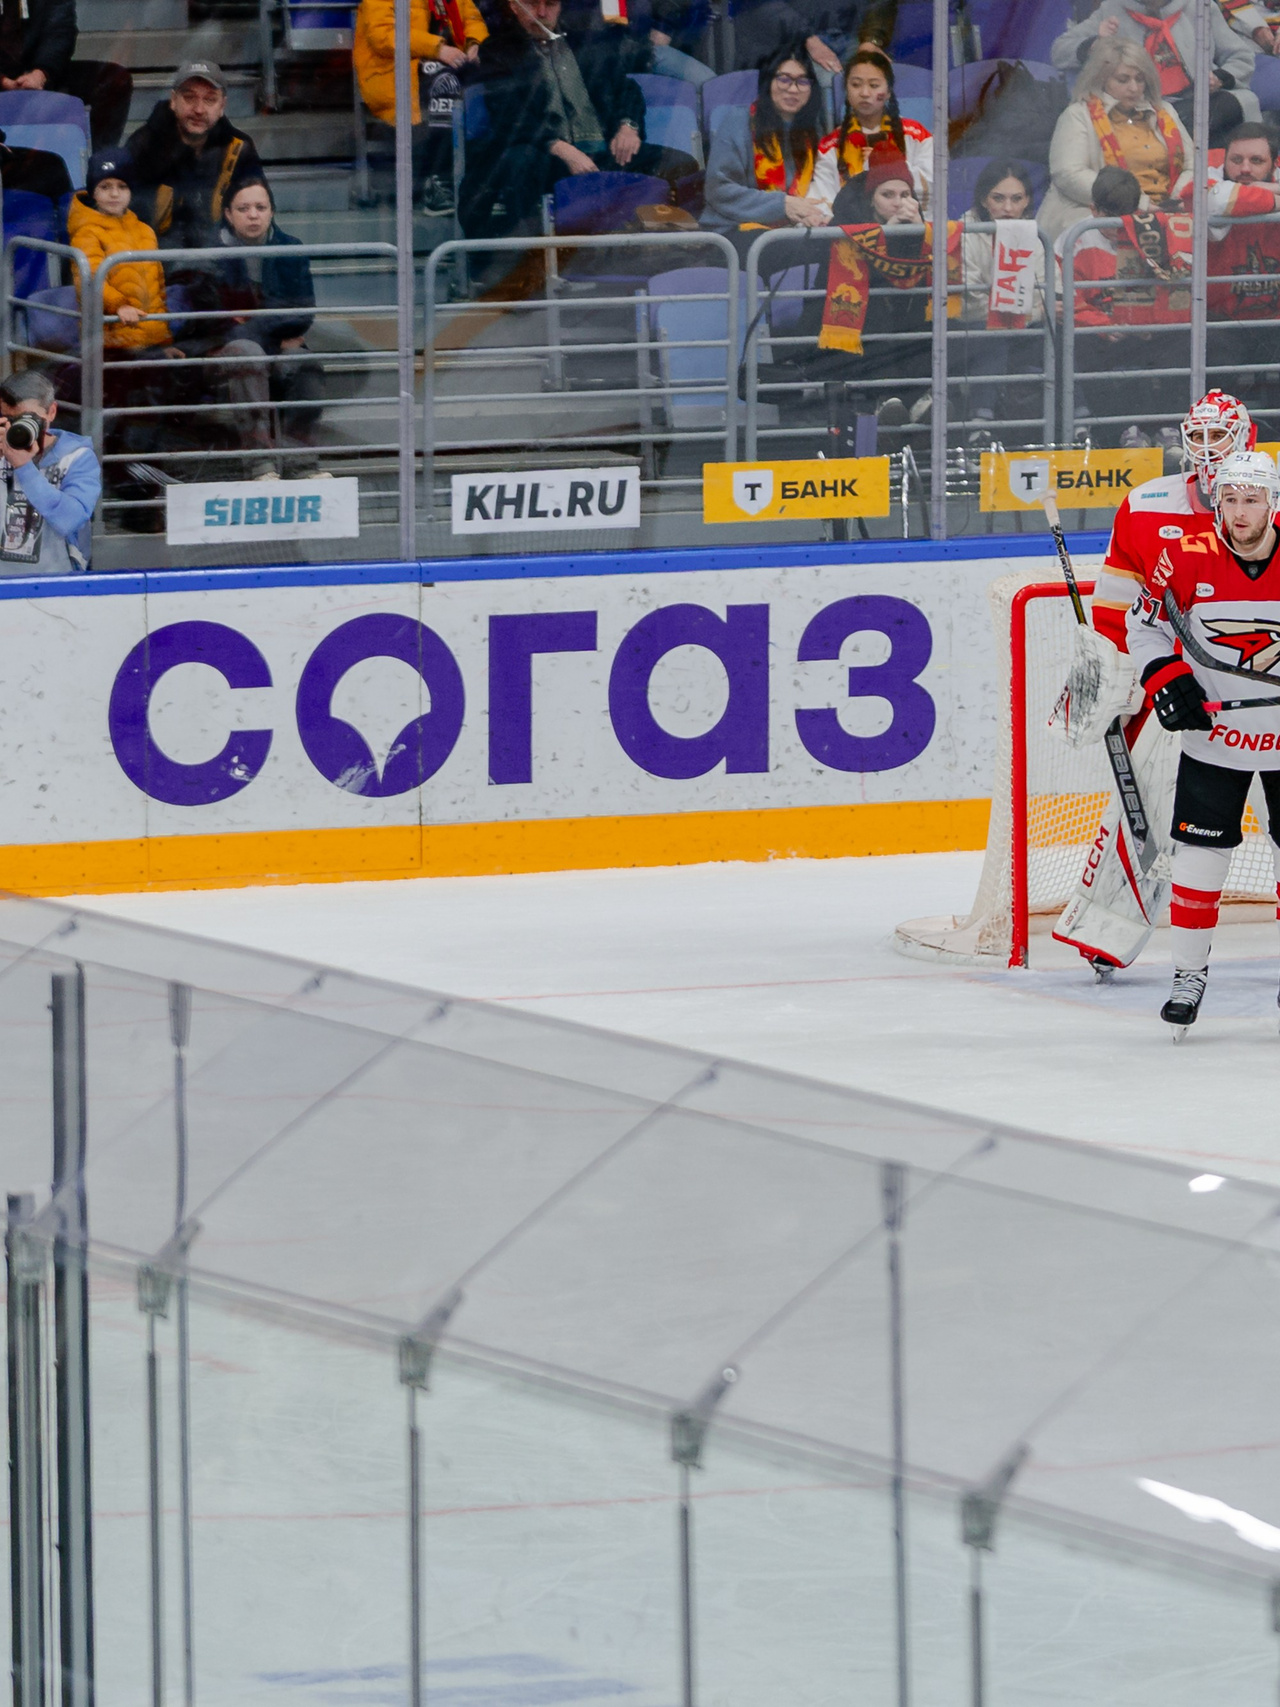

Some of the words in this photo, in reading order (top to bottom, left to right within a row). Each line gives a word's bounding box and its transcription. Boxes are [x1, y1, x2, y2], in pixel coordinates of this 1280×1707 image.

[781, 478, 859, 500] БАНК
[1056, 468, 1133, 489] БАНК
[204, 495, 322, 526] SIBUR
[464, 480, 628, 521] KHL.RU
[1082, 825, 1110, 887] CCM
